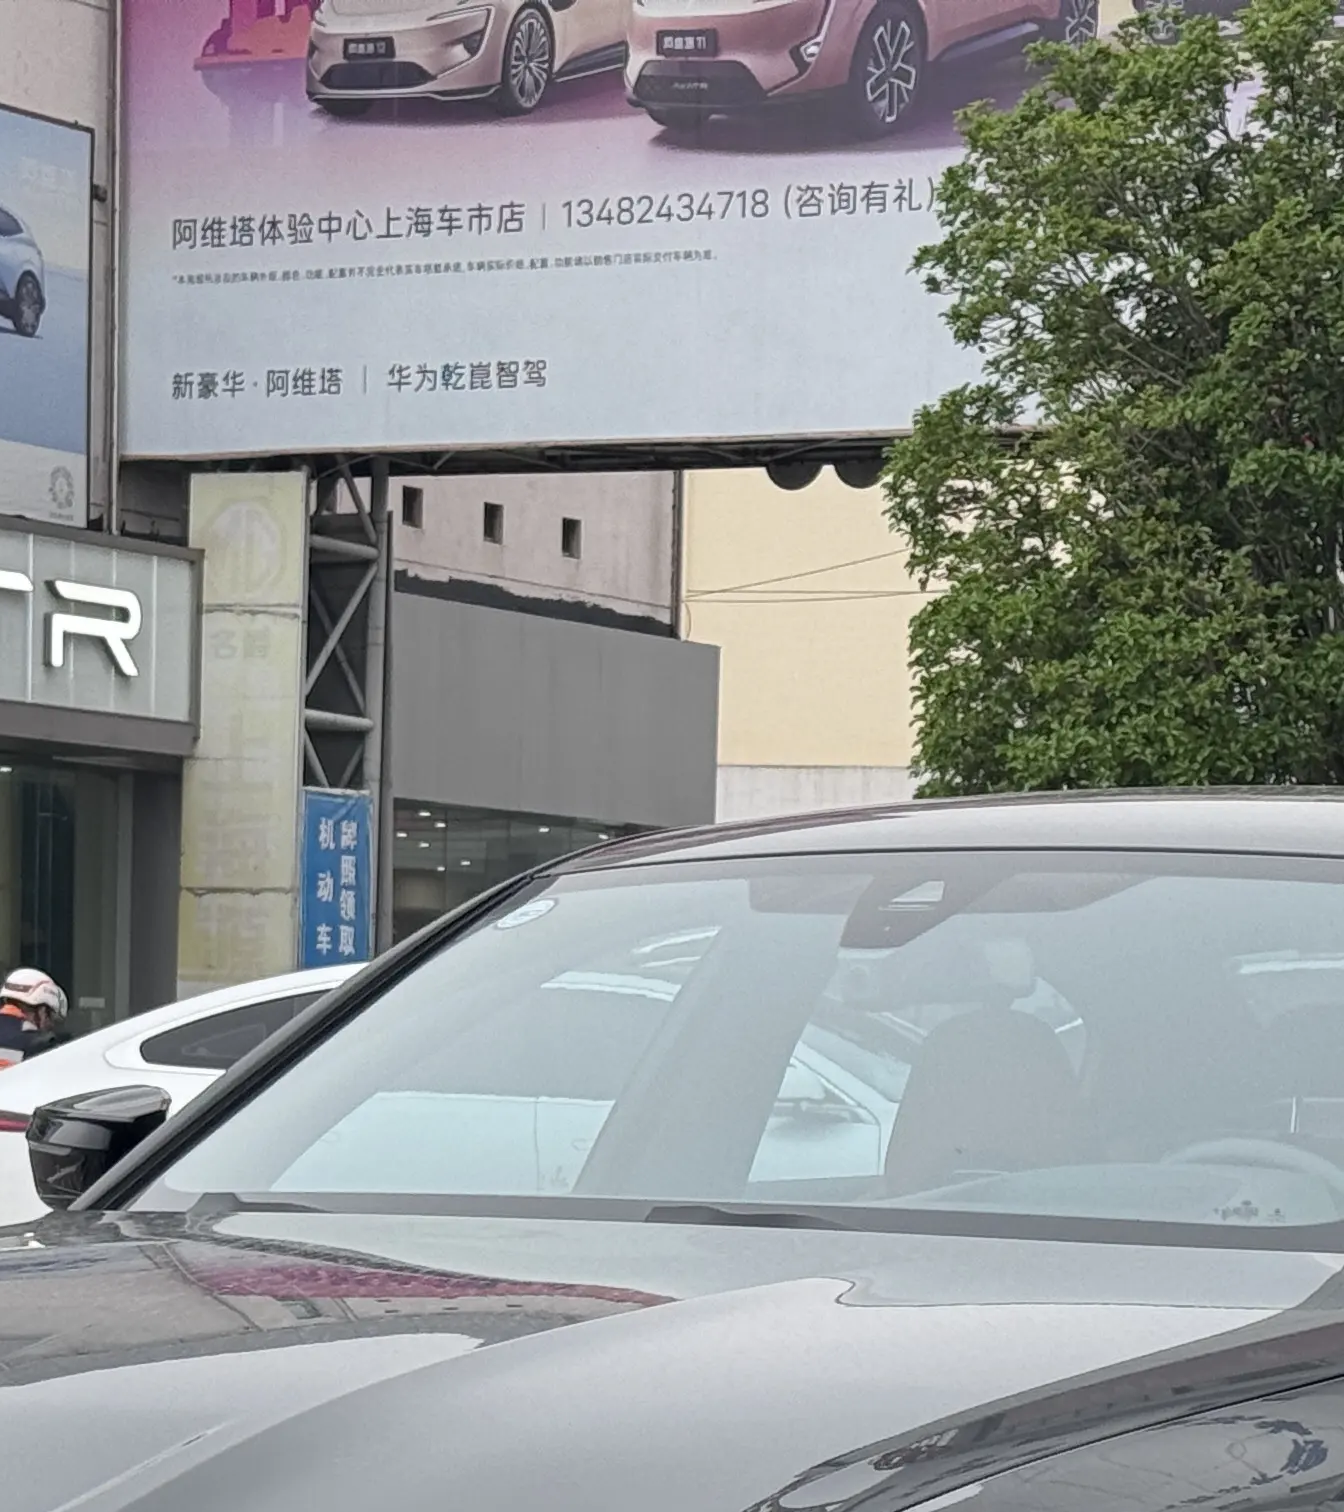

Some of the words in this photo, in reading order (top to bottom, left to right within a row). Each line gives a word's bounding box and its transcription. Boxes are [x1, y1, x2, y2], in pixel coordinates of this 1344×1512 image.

[171, 201, 526, 250] 阿维塔体验中心上海车市店
[561, 188, 770, 228] 13482434718
[171, 367, 344, 401] 新豪华·阿维塔
[387, 359, 547, 393] 华为乾崑智驾
[315, 817, 336, 956] 机动车
[339, 820, 358, 957] 牌照领取
